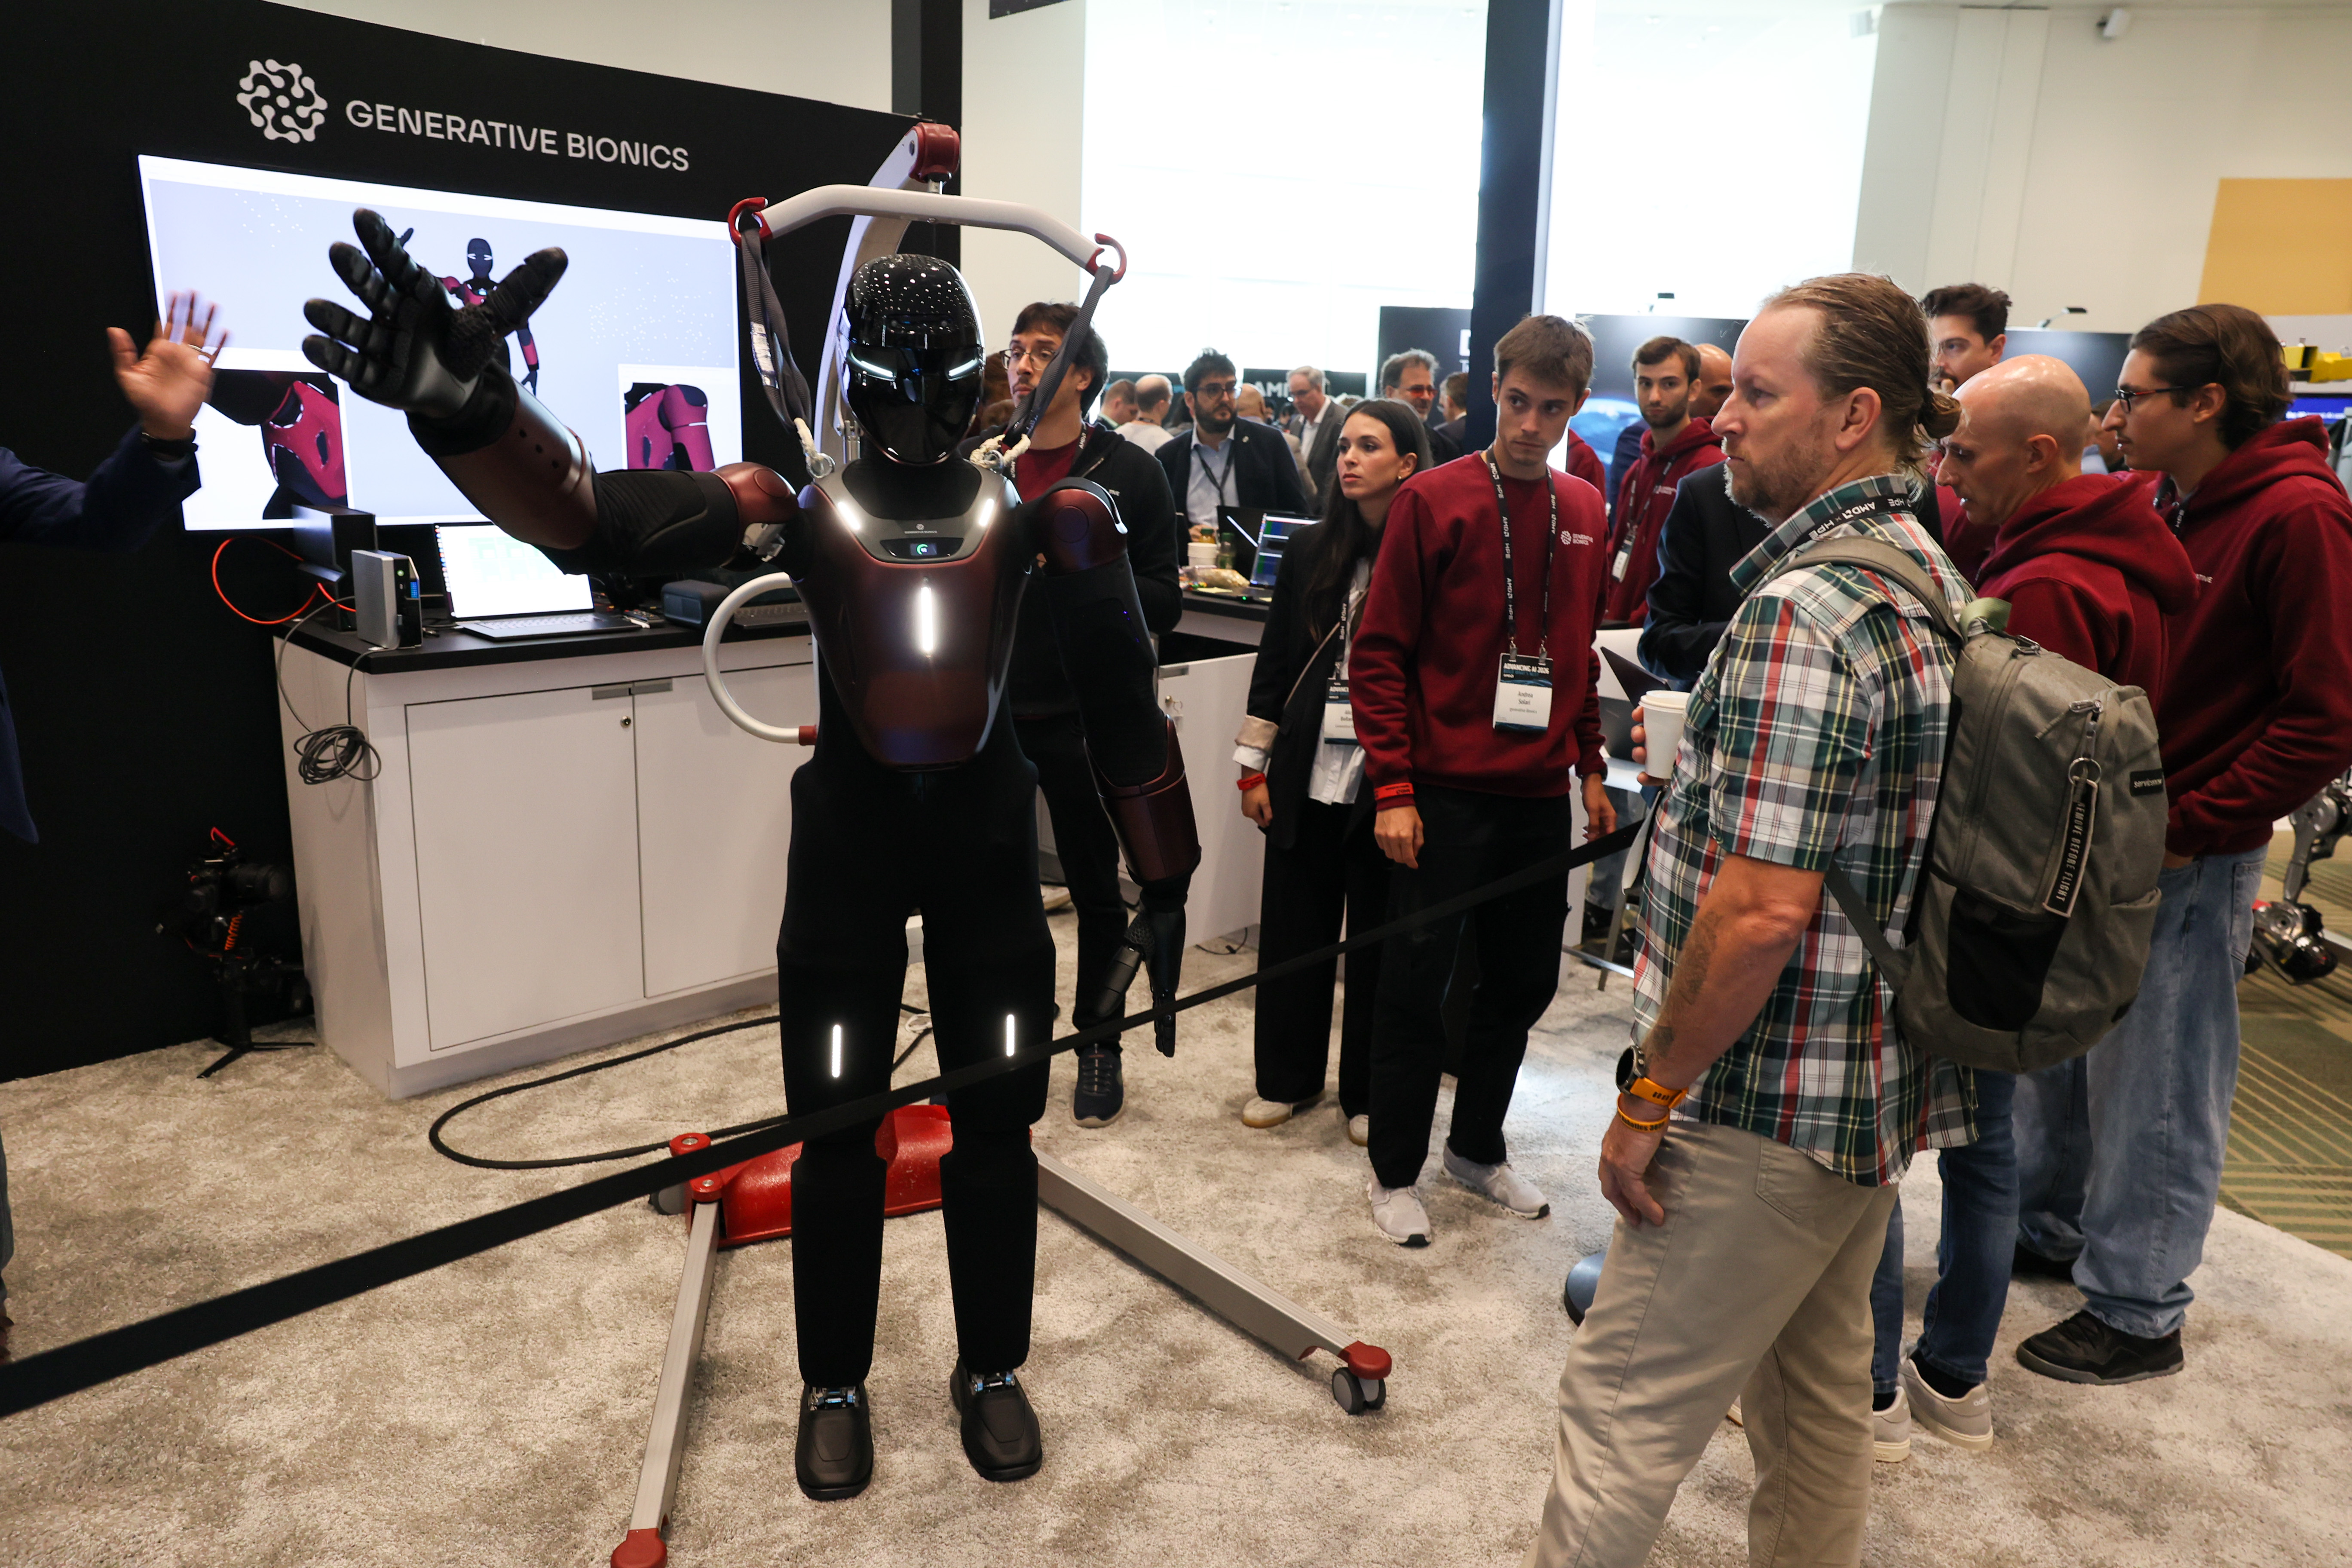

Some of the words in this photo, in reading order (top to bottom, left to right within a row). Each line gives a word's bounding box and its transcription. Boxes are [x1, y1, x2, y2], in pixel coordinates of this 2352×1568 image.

[346, 100, 558, 155] GENERATIVE
[567, 133, 689, 172] BIONICS
[1490, 463, 1498, 478] AMD
[1847, 502, 1876, 517] AMD
[1887, 498, 1904, 507] HPE
[1808, 520, 1835, 538] HPE
[2066, 838, 2081, 870] BEFORE
[2056, 871, 2073, 902] FLIGHT
